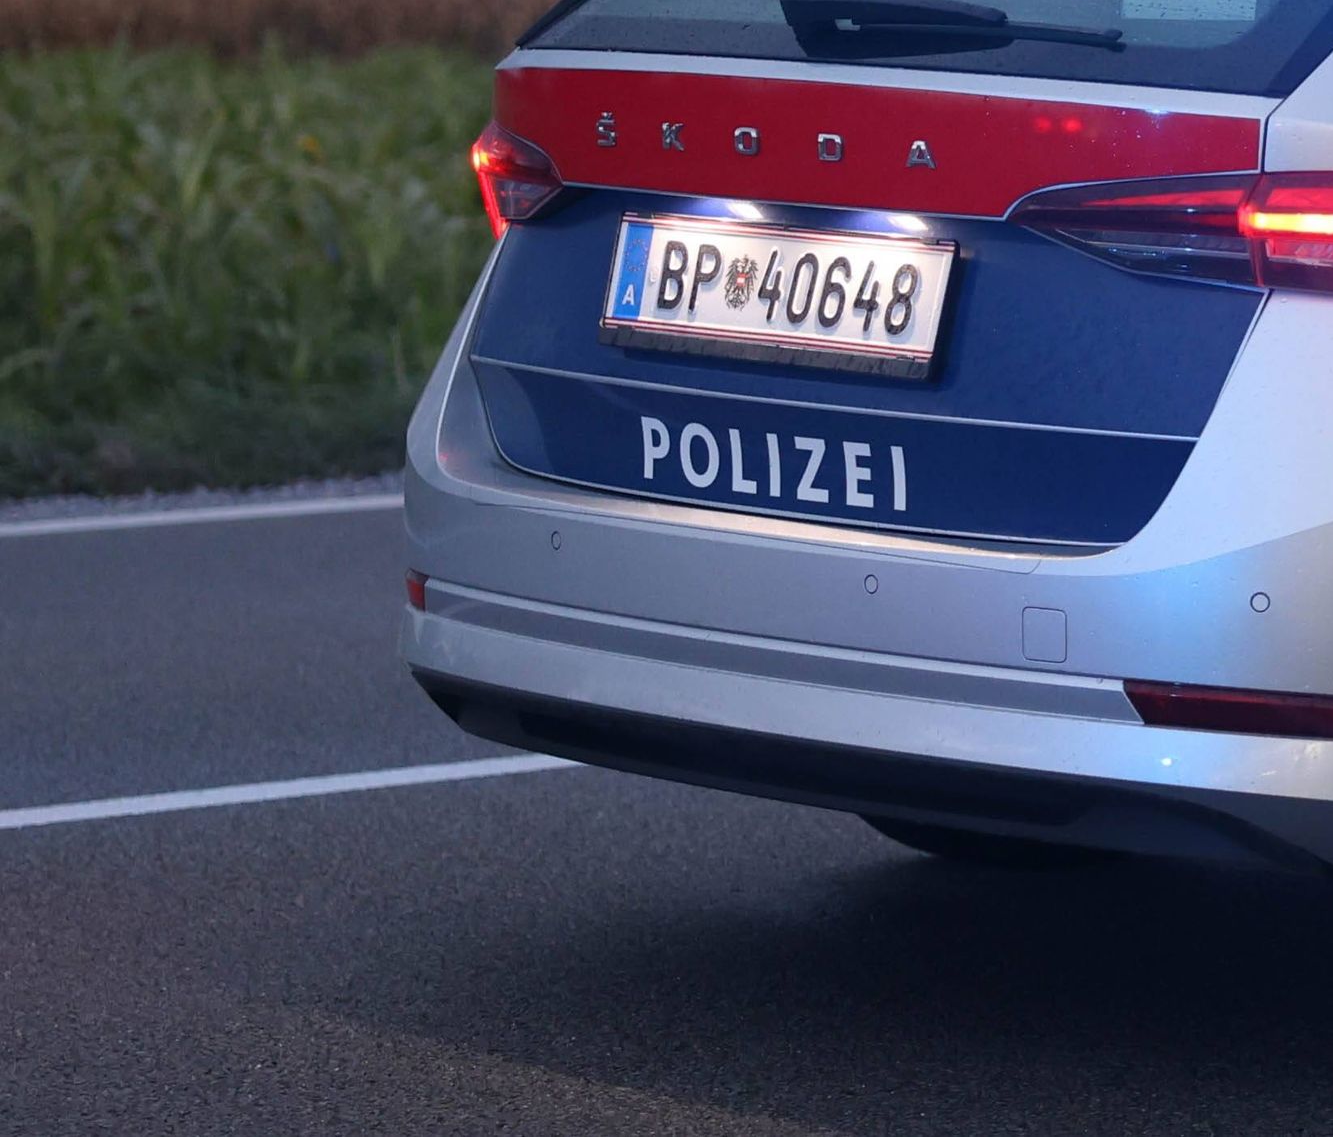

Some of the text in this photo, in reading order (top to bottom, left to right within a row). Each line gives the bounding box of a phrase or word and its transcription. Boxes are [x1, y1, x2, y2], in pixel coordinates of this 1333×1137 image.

[595, 111, 937, 169] ŠKODA
[621, 283, 635, 307] A
[657, 239, 920, 336] BP 40648
[640, 415, 907, 512] POLIZEI
